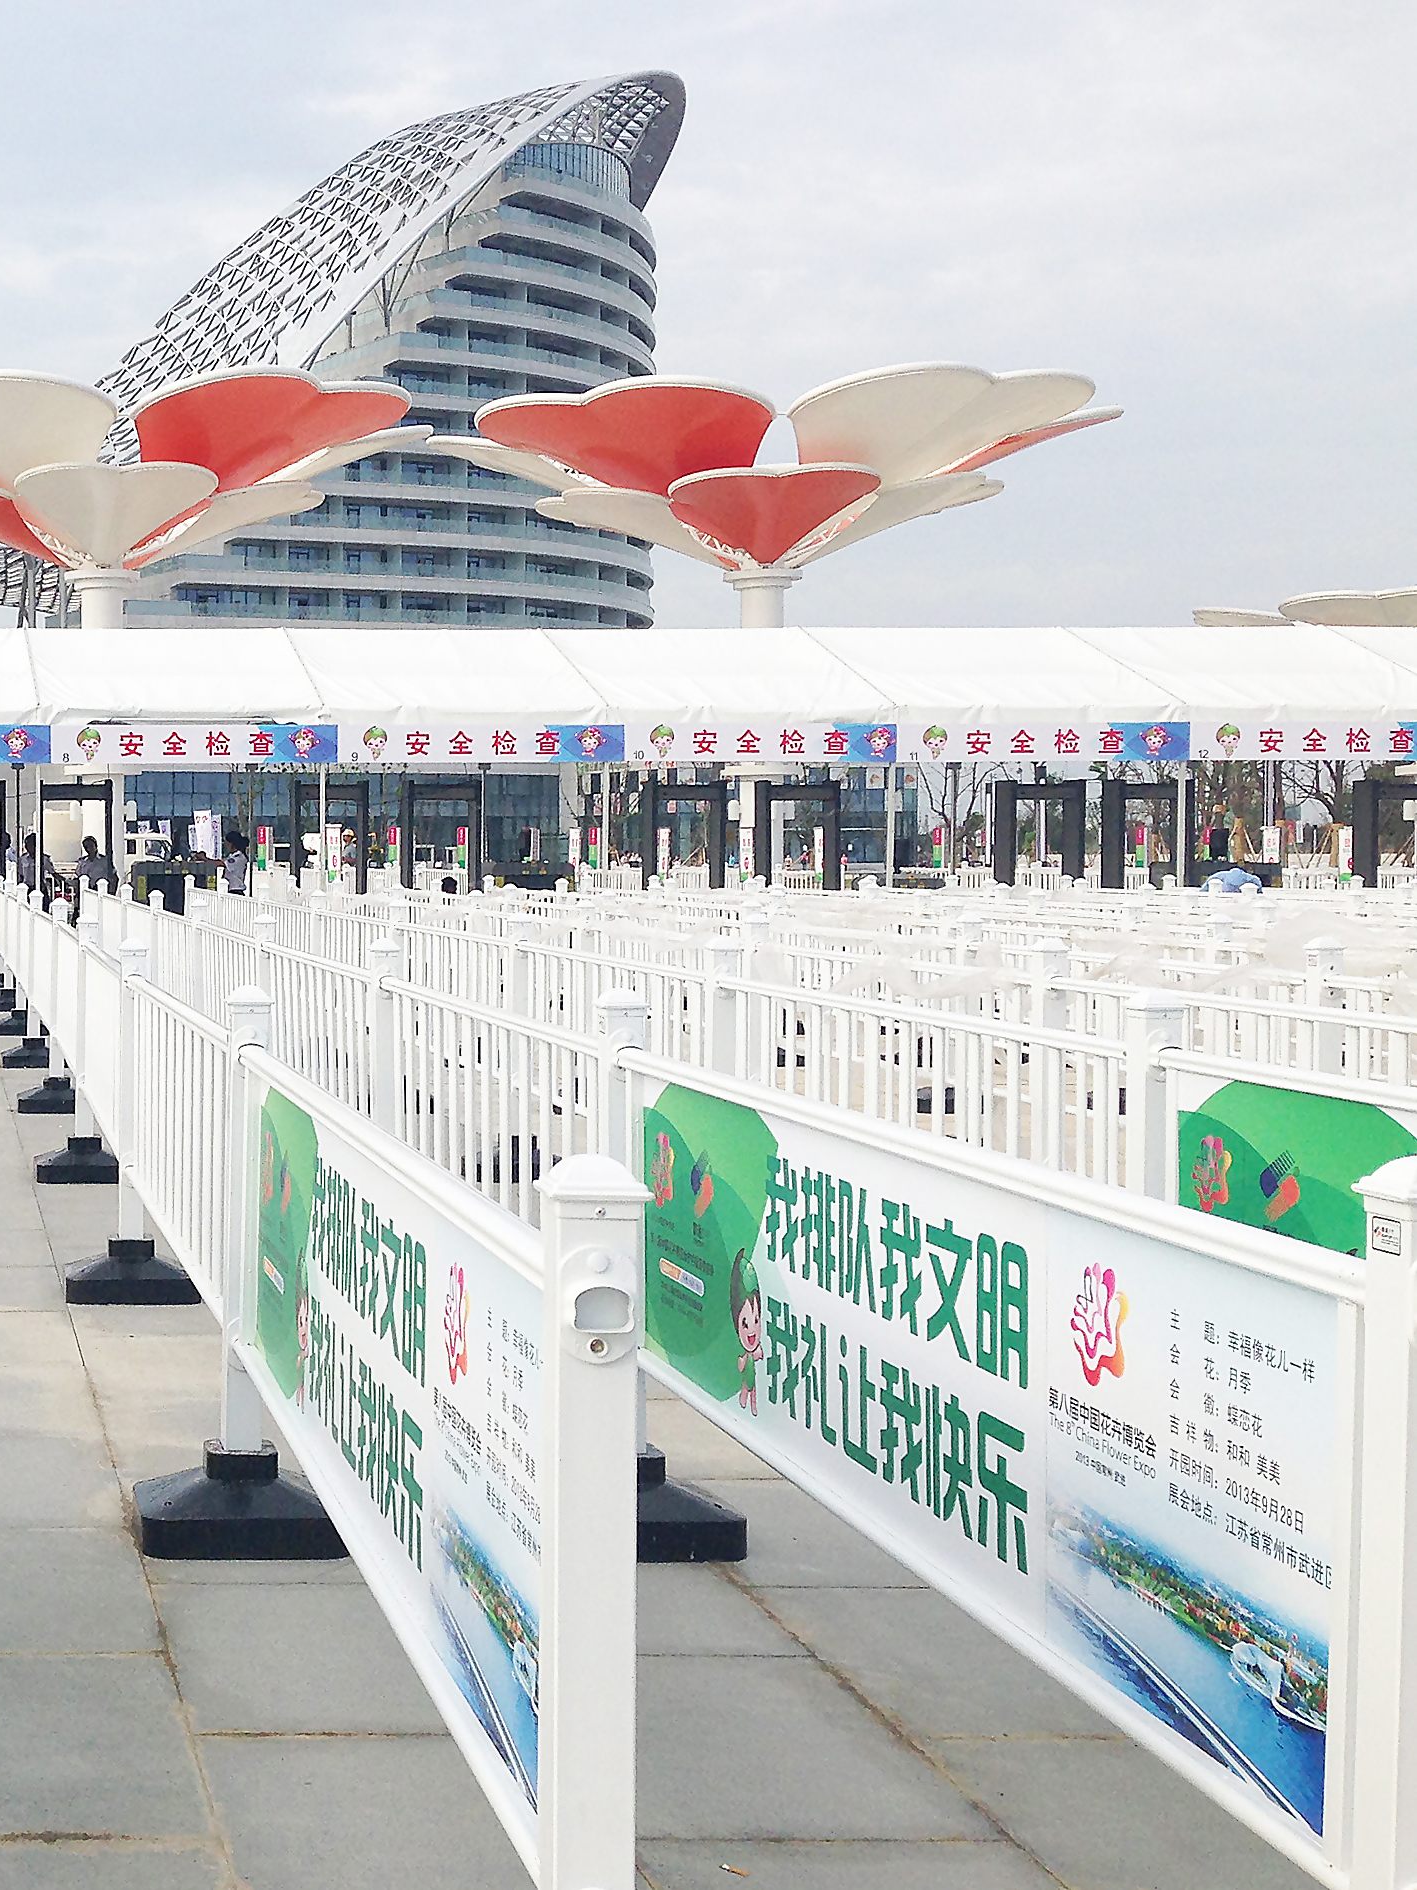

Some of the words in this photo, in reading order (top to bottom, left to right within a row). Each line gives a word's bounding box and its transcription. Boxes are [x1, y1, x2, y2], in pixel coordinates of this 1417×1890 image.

[119, 731, 274, 756] 安全检查
[406, 730, 560, 755] 安全检查
[693, 729, 848, 755] 安全检查
[966, 729, 1124, 754] 安全检查
[1259, 728, 1414, 754] 安全检查
[62, 753, 70, 763] 8
[351, 752, 359, 762] 9
[633, 750, 644, 760] 10
[909, 752, 918, 761] 11
[1198, 750, 1209, 759] 12
[312, 1157, 426, 1387] 我排队我文明
[766, 1155, 1029, 1390] 我排队我文明
[309, 1295, 423, 1573] 我礼让我快乐
[1049, 1386, 1157, 1460] 第八届中国花卉博览会
[766, 1296, 1028, 1576] 我礼让我快乐
[1049, 1411, 1064, 1433] The
[1076, 1426, 1099, 1450] China
[1102, 1439, 1131, 1466] Flower
[1134, 1455, 1156, 1480] Expo
